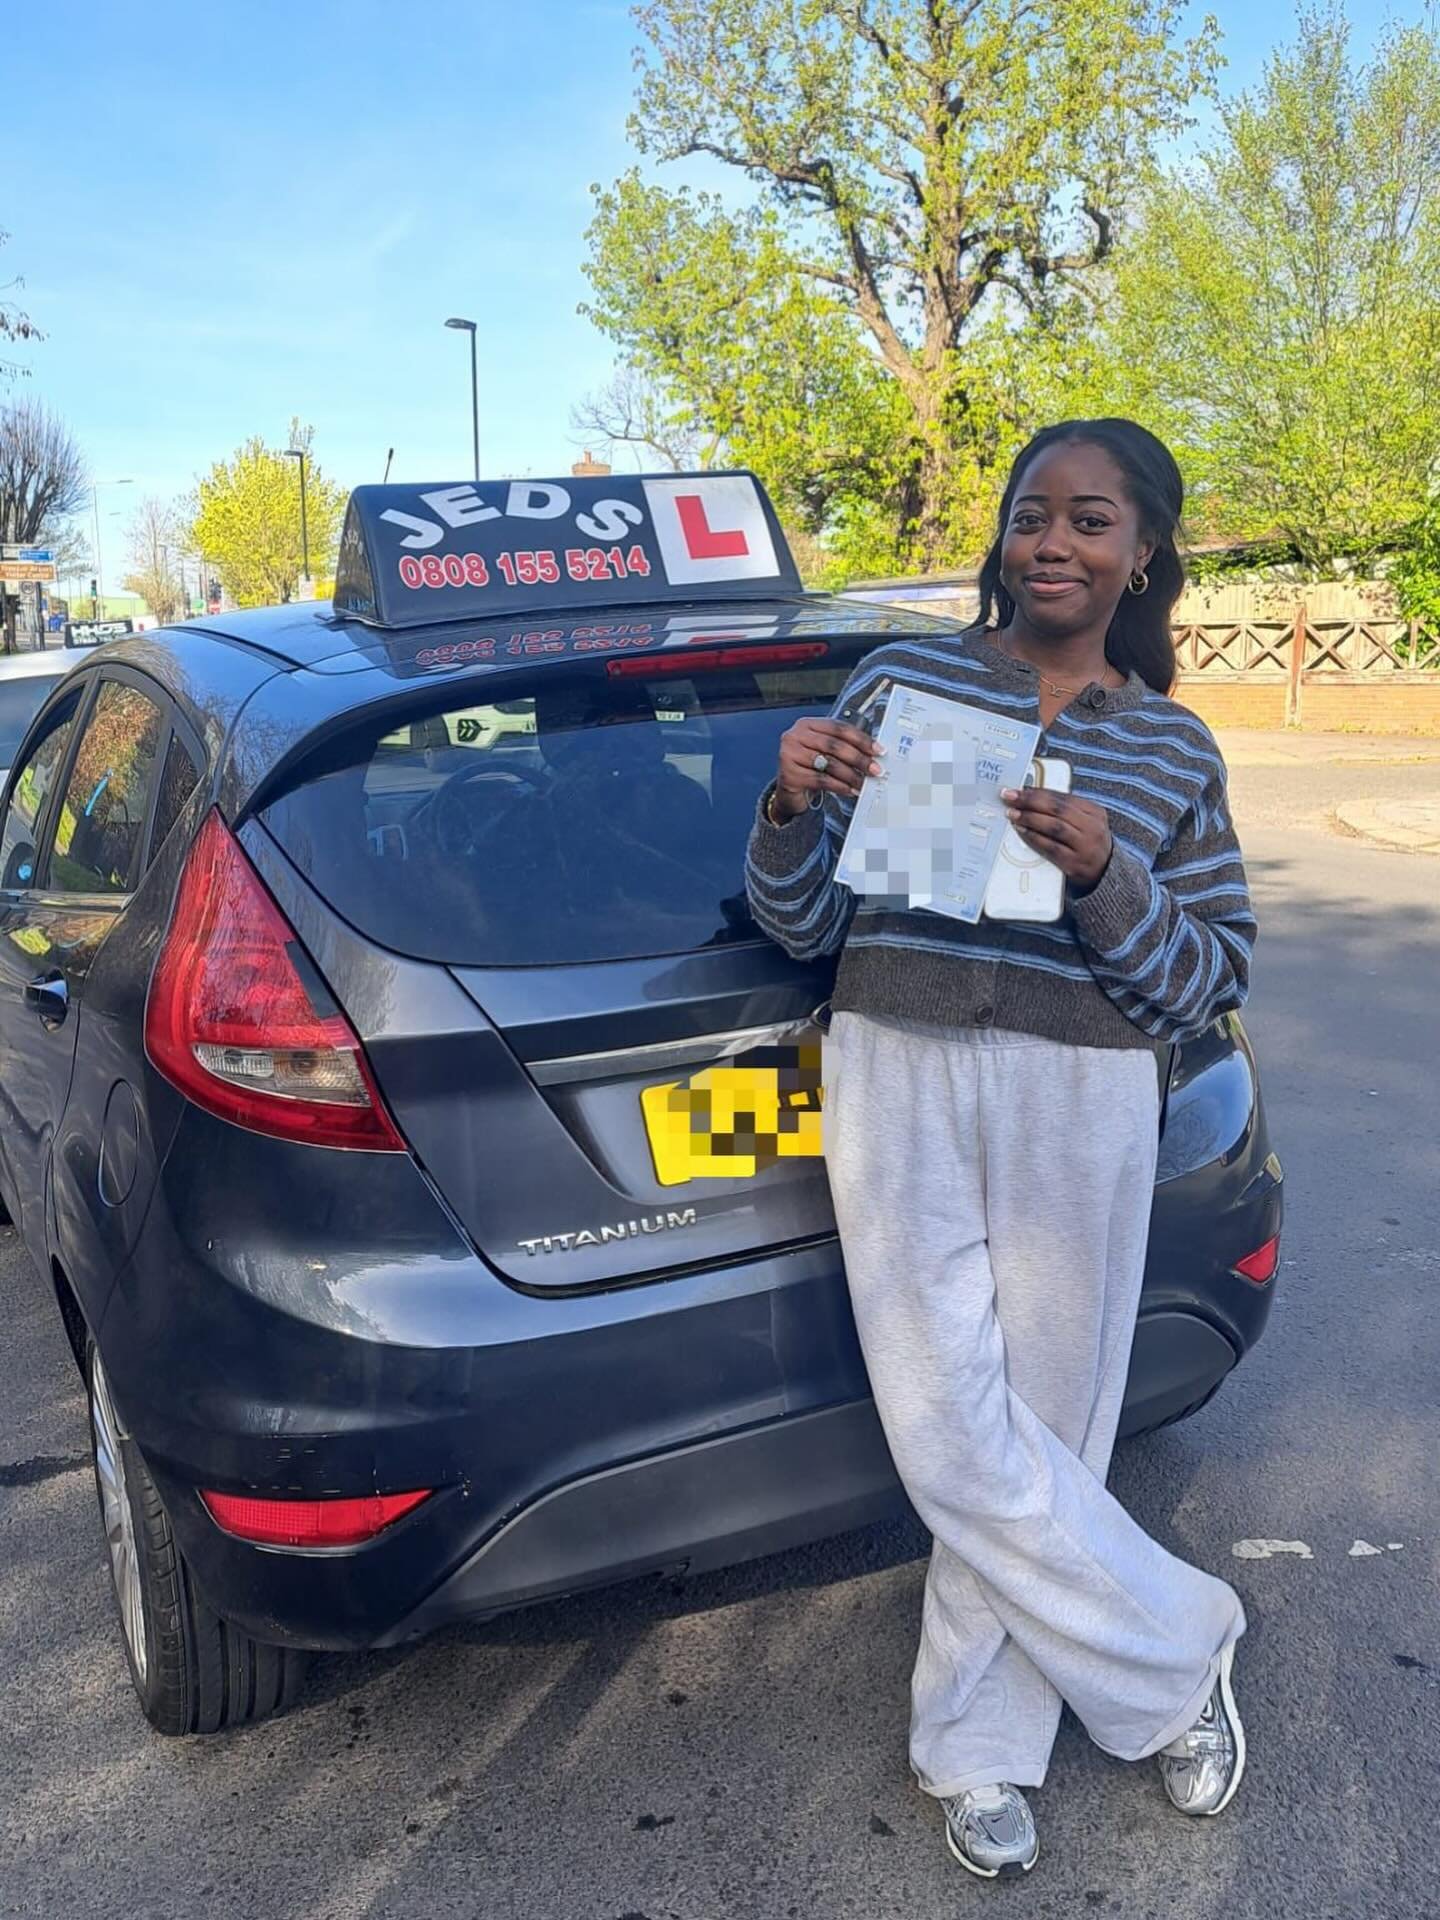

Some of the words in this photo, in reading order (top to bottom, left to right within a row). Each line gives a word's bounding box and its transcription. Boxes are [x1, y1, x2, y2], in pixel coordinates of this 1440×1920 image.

[379, 482, 644, 549] JEDS
[675, 495, 749, 560] L
[399, 554, 489, 589] 0808
[497, 550, 560, 585] 155
[564, 545, 651, 581] 5214
[517, 1208, 697, 1256] TITANIUM
